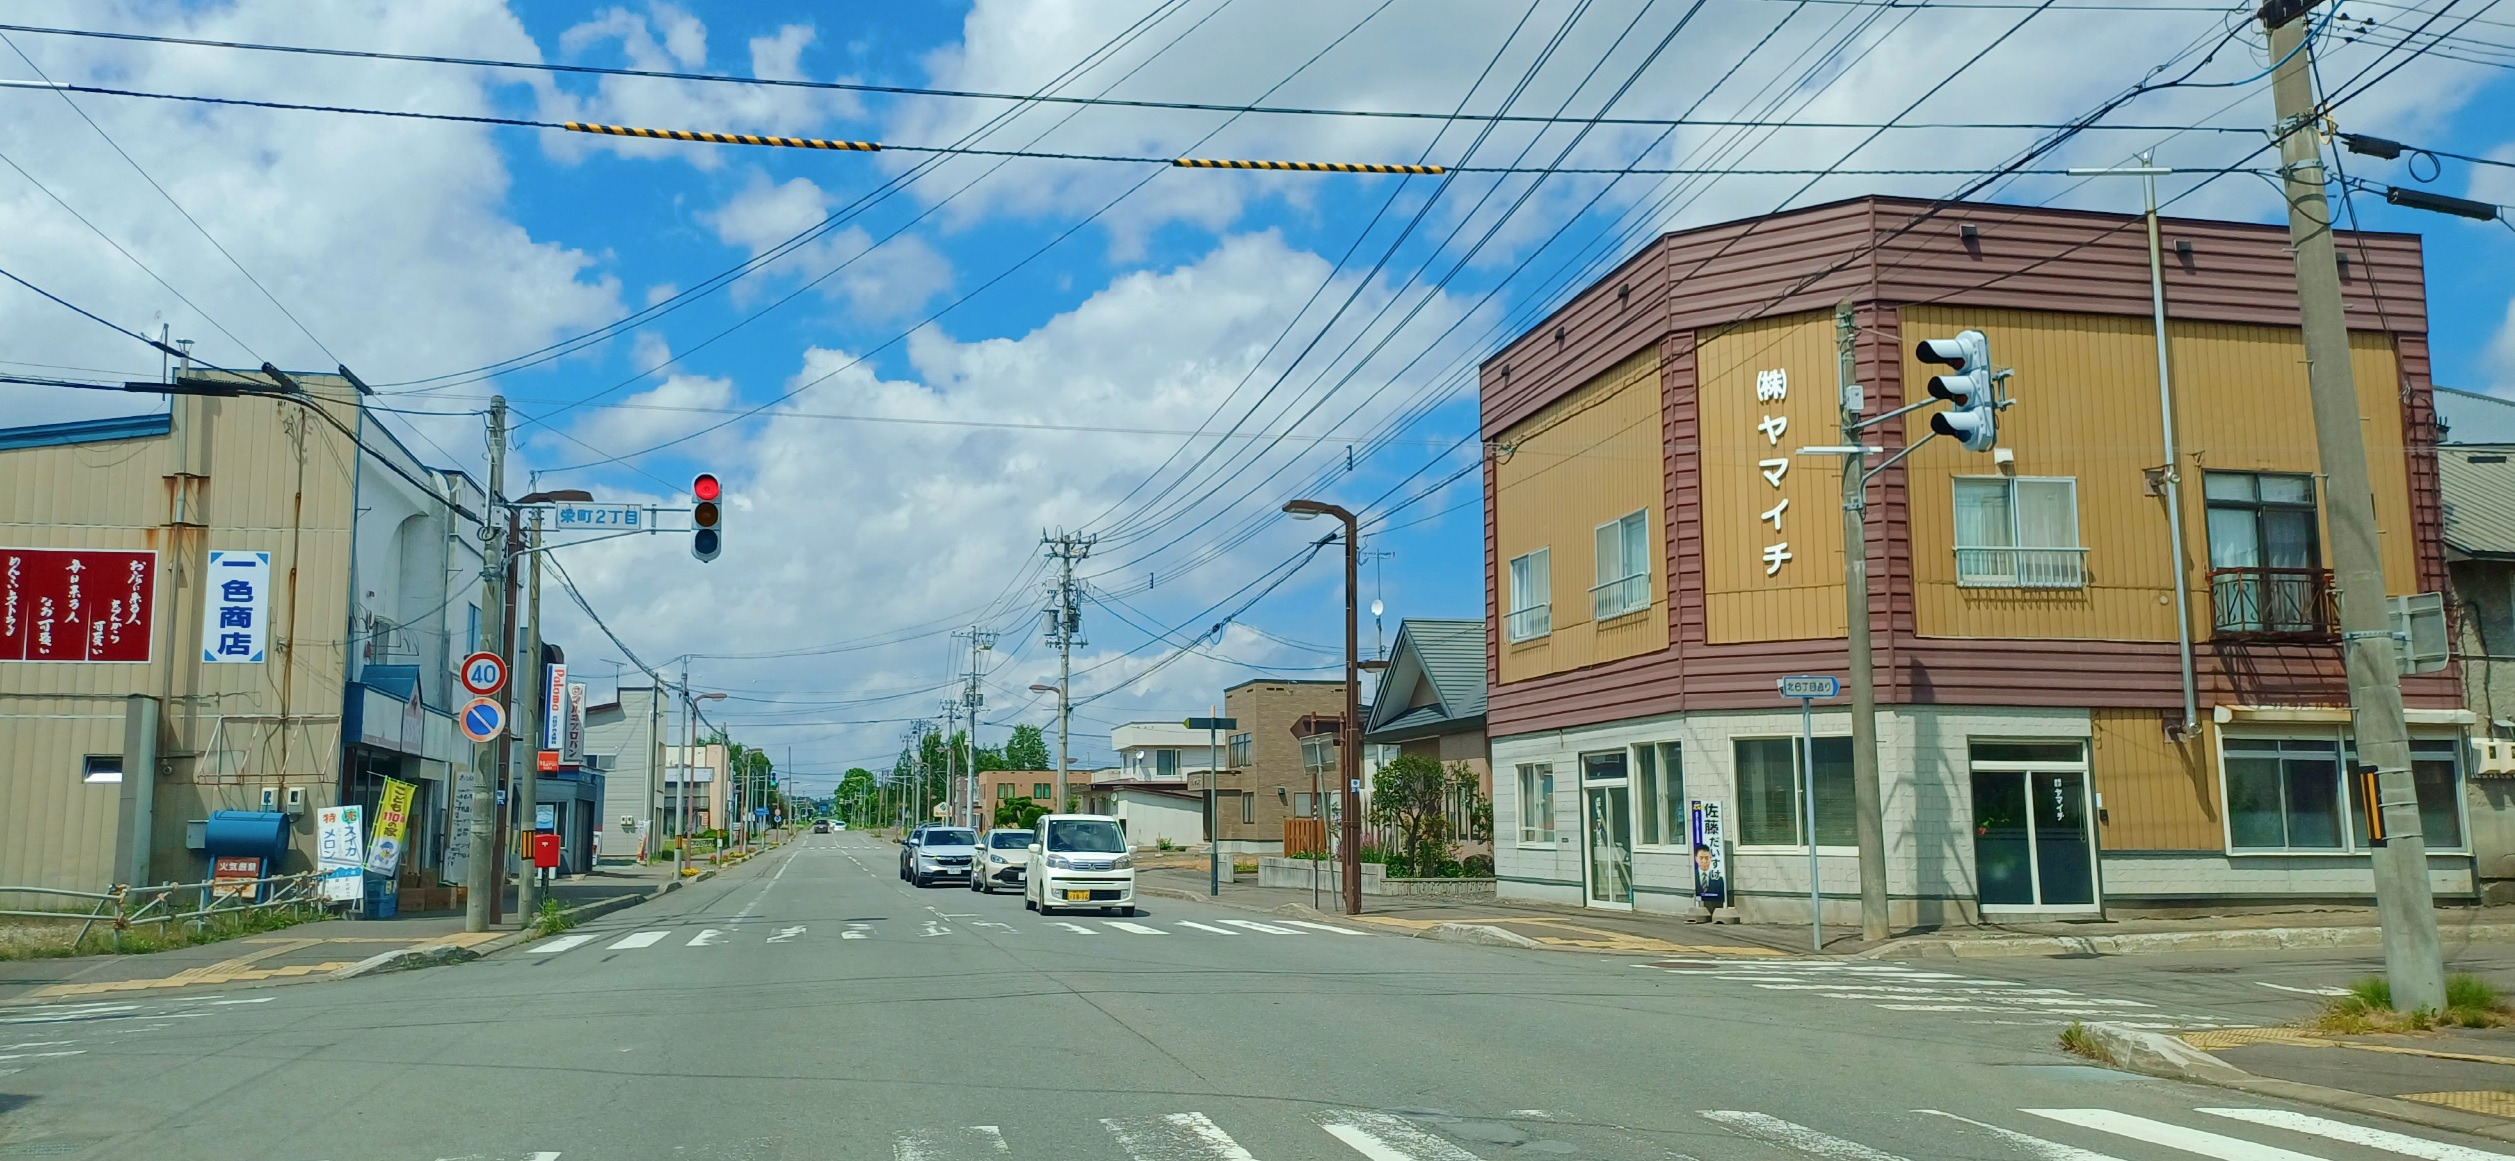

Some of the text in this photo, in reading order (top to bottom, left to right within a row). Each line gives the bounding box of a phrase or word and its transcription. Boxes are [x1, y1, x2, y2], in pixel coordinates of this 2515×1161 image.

[560, 508, 637, 524] 栄町2丁目
[217, 560, 256, 656] 一色商店
[471, 664, 496, 683] 40
[552, 669, 564, 711] Paloma
[323, 828, 336, 859] メロン
[344, 826, 357, 857] スイカ
[1704, 803, 1721, 880] 佐藤だいすけ
